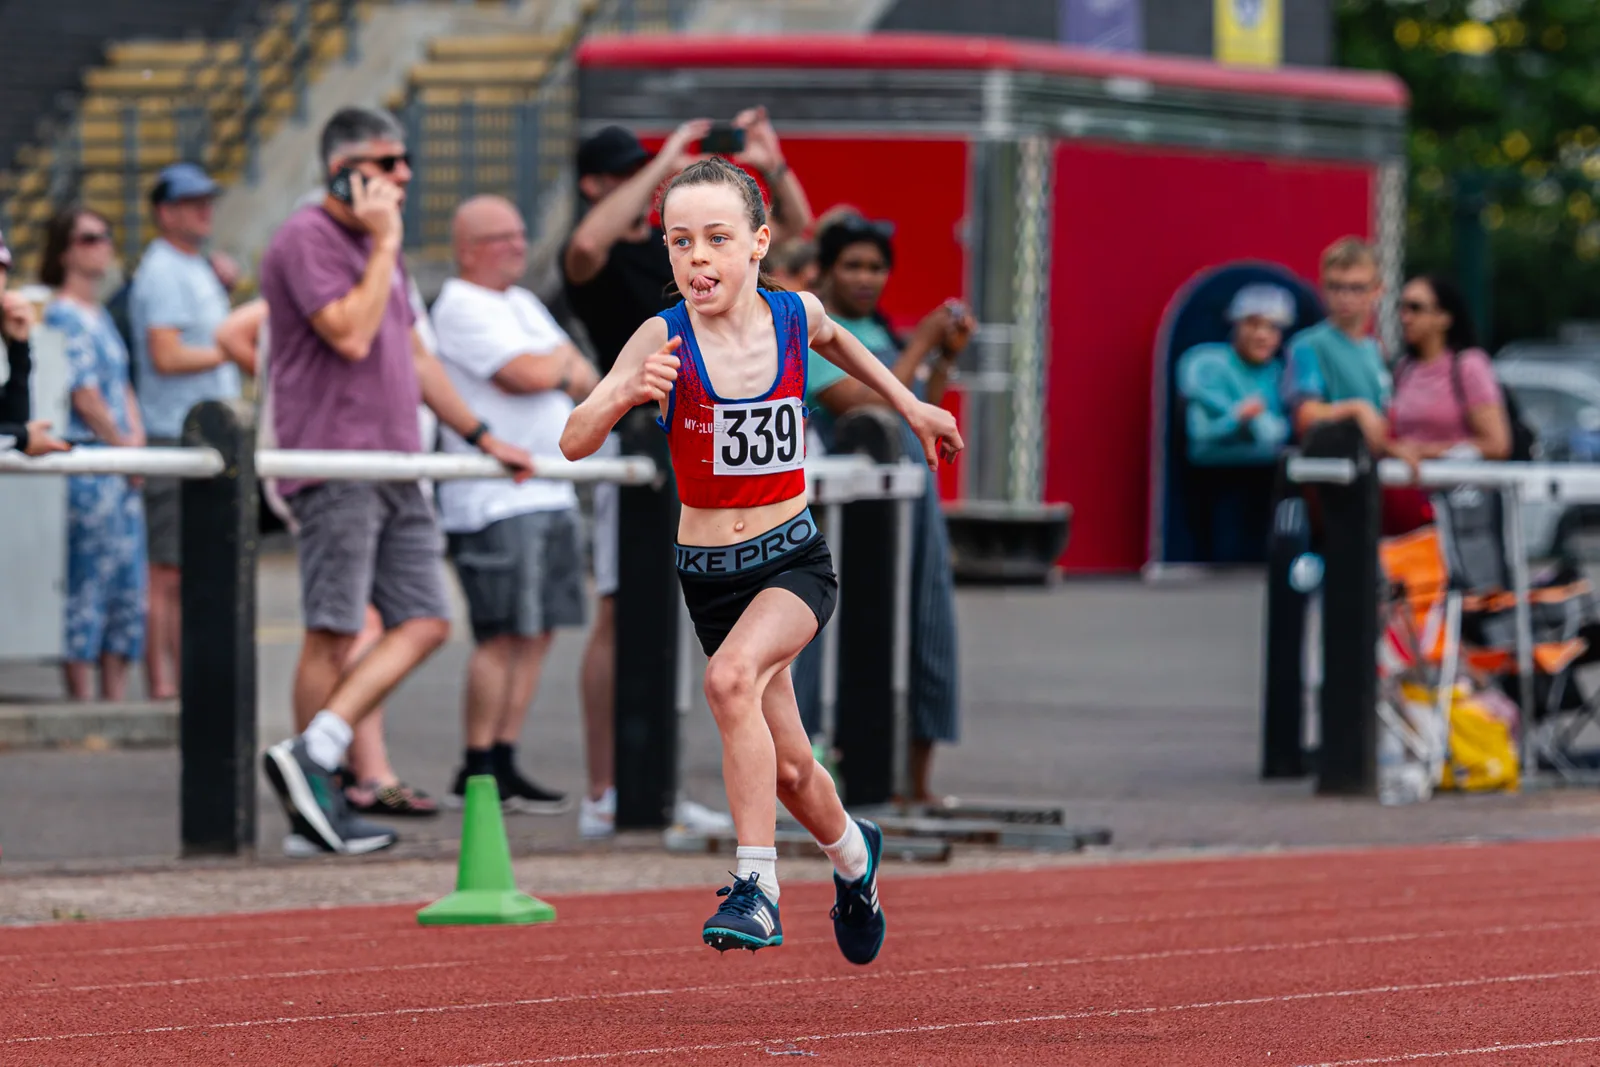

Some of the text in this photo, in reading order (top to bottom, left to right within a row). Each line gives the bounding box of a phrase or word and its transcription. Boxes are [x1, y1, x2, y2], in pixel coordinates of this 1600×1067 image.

[721, 404, 797, 466] 339
[678, 518, 812, 573] IKE PRO
